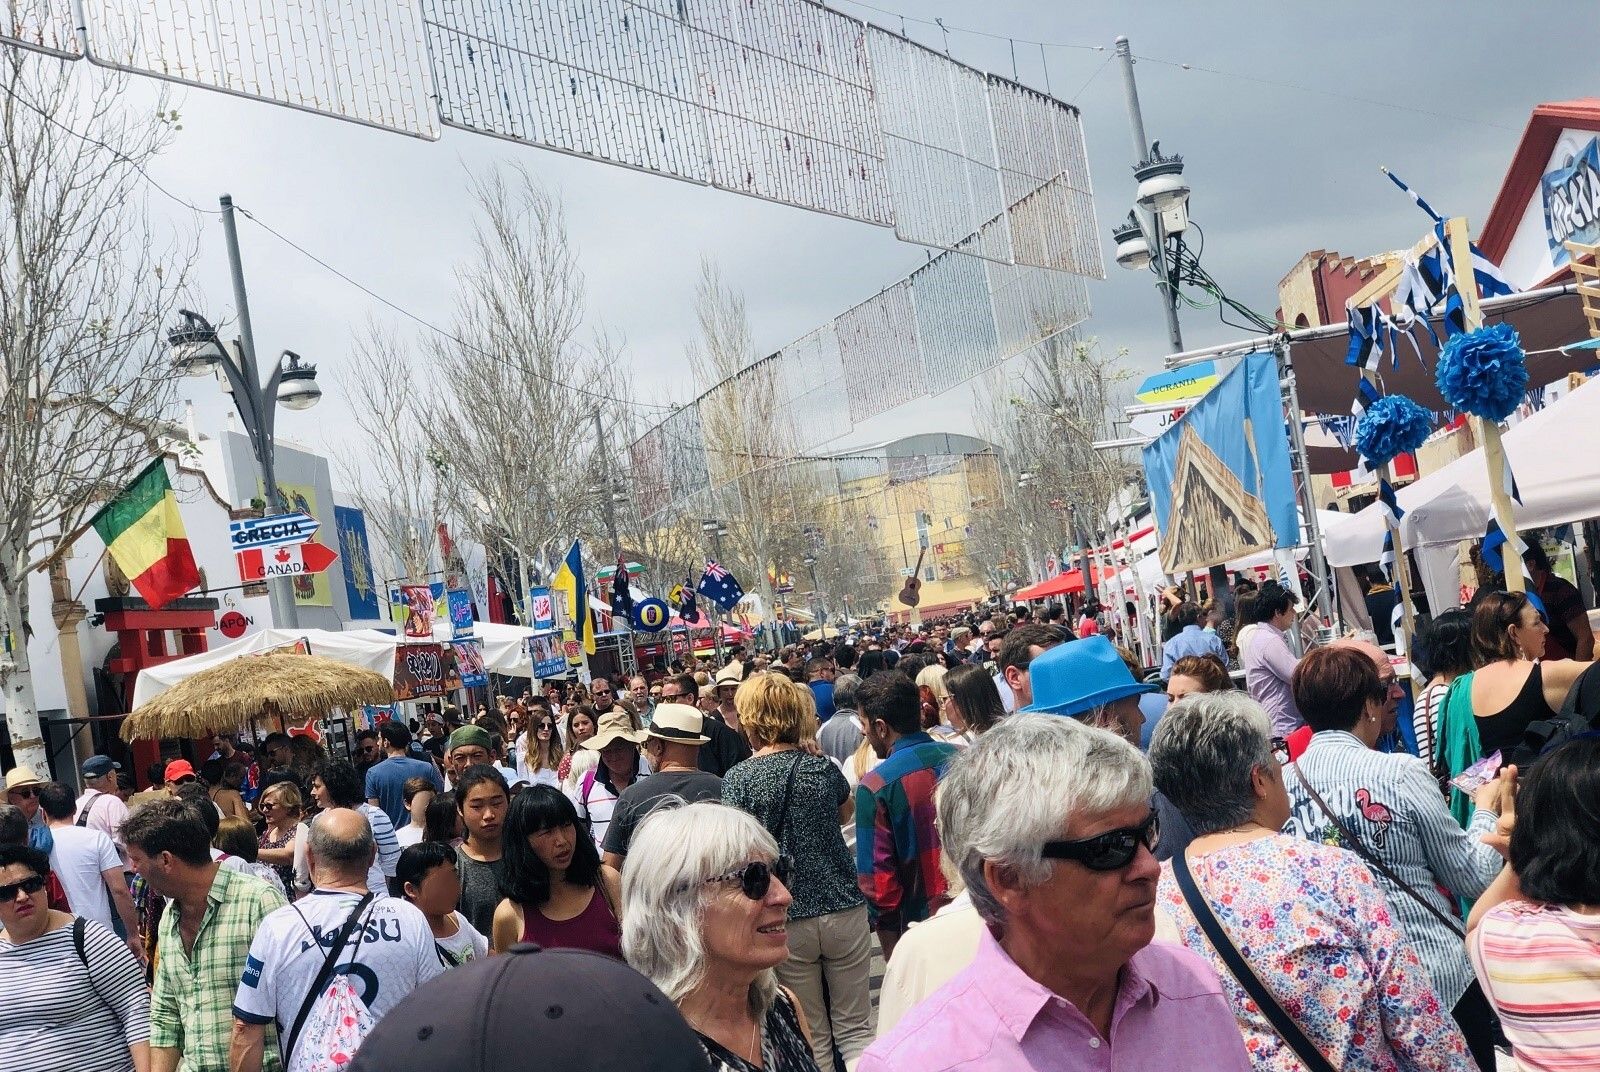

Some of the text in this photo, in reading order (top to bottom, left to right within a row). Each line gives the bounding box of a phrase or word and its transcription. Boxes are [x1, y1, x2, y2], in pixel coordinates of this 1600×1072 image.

[1152, 377, 1197, 395] UCRANIA
[235, 521, 302, 544] GRECIA
[257, 562, 311, 577] CANADA
